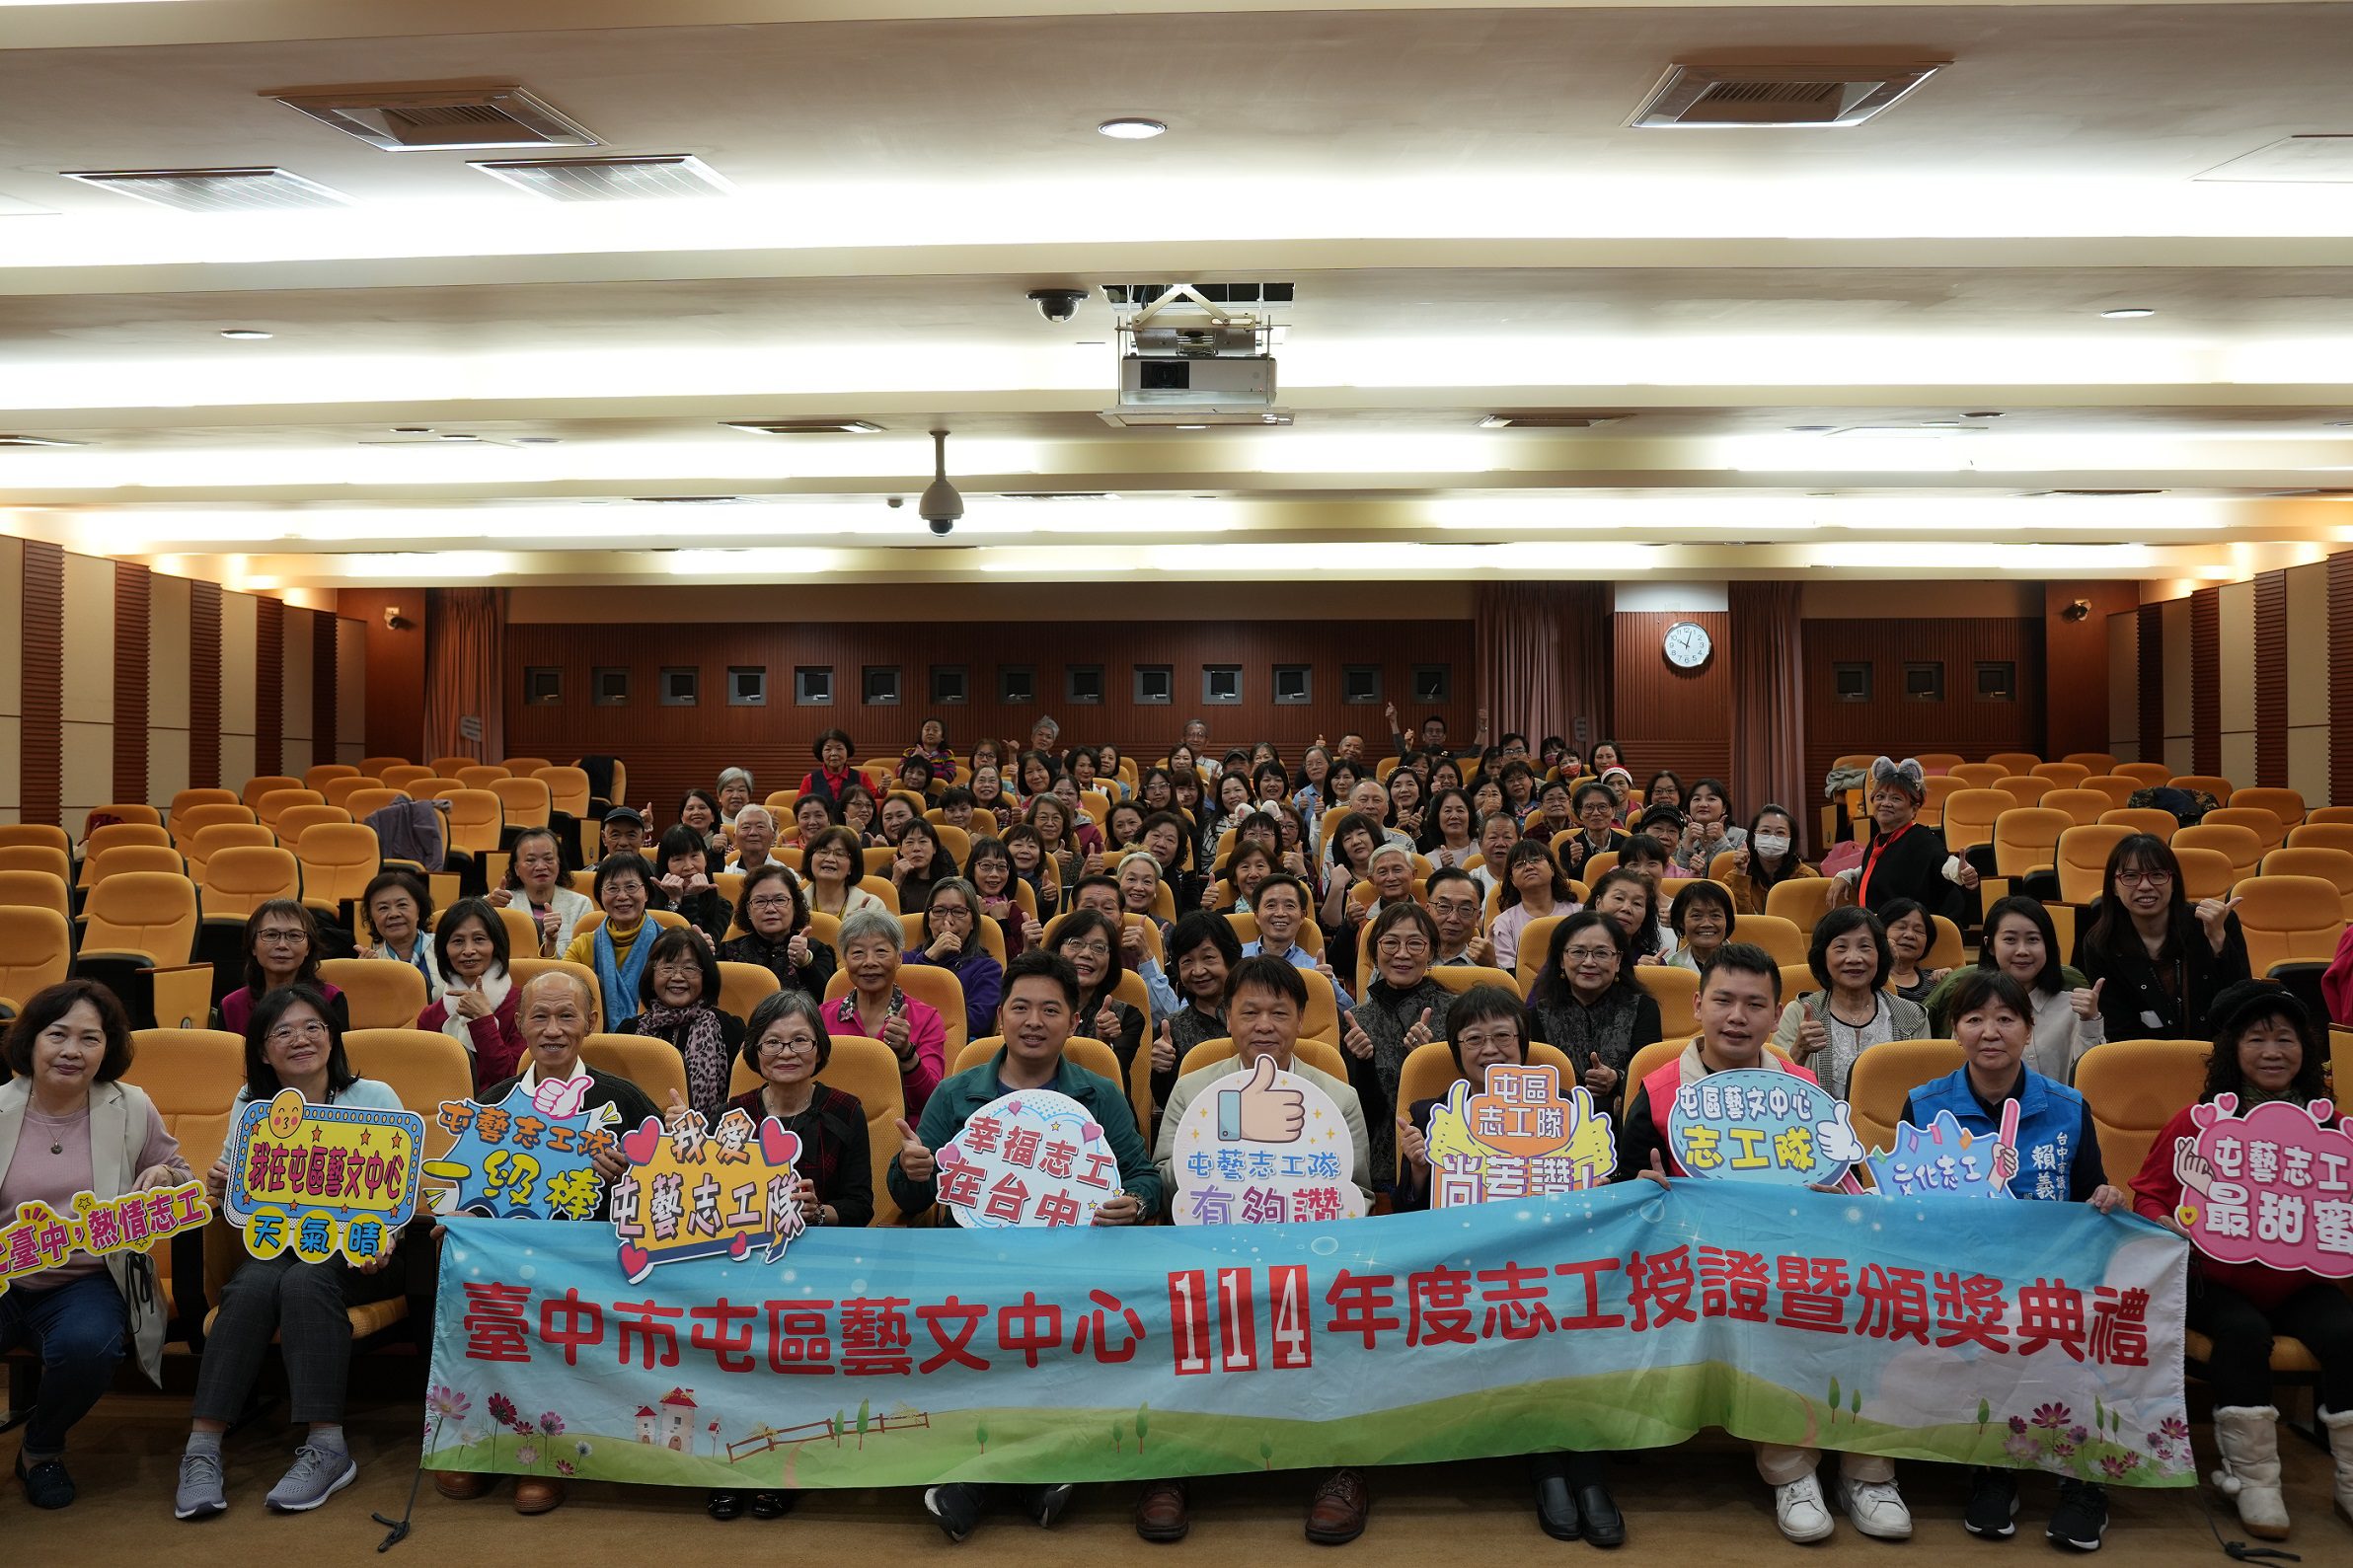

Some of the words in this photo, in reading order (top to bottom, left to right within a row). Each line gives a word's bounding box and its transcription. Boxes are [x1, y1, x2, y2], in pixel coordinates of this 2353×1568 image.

[1493, 1073, 1550, 1104] 屯區
[1678, 1084, 1814, 1122] 屯區藝文中心
[439, 1101, 615, 1157] 屯藝志工隊
[670, 1110, 754, 1165] 我愛
[1478, 1105, 1564, 1140] 志工隊
[1682, 1123, 1817, 1173] 志工隊
[248, 1141, 405, 1199] 我在屯區藝文中心
[963, 1115, 1114, 1190] 幸福志工
[1187, 1148, 1341, 1182] 屯藝志工隊
[1892, 1155, 1982, 1196] 文化志工
[2213, 1136, 2348, 1191] 屯藝志工
[421, 1149, 602, 1222] 一級棒
[611, 1169, 805, 1241] 屯藝志工隊
[939, 1157, 1102, 1227] 在台中
[1189, 1184, 1342, 1226] 有夠讚
[0, 1186, 207, 1275] 臺中，熱情志工
[253, 1215, 383, 1258] 天氣晴
[2204, 1181, 2353, 1255] 最甜蜜
